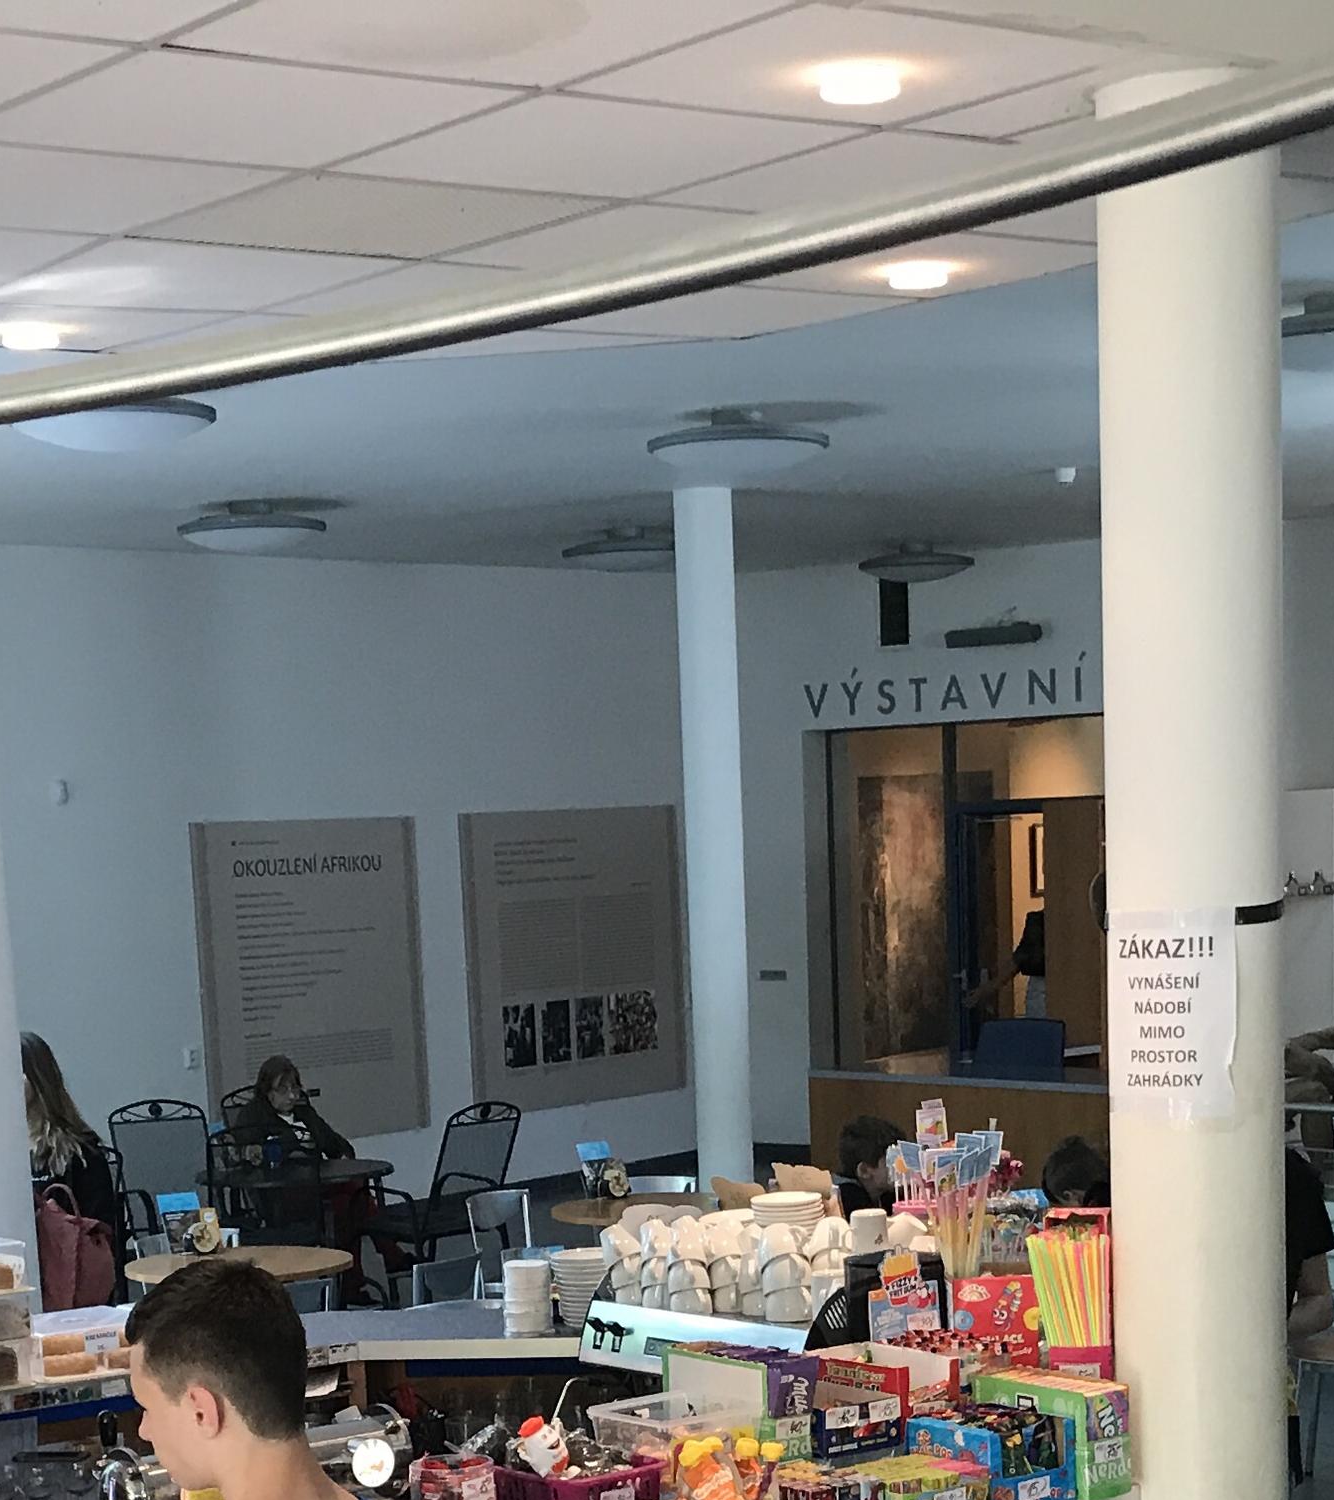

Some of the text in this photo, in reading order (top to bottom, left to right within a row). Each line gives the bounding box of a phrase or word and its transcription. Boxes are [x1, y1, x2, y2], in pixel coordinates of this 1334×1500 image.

[803, 651, 1086, 718] VÝSTAVNÍ
[233, 853, 382, 878] OKOUZLENÍ AFRIKOU
[1119, 933, 1214, 959] ZÁKAZ!!!
[1128, 972, 1200, 990] VYNÁŠENÍ
[1134, 998, 1192, 1014] NÁDOBÍ
[1140, 1025, 1185, 1039] MIMO
[1131, 1050, 1197, 1063] PROSTOR
[1127, 1071, 1203, 1087] ZAHRÁDKY
